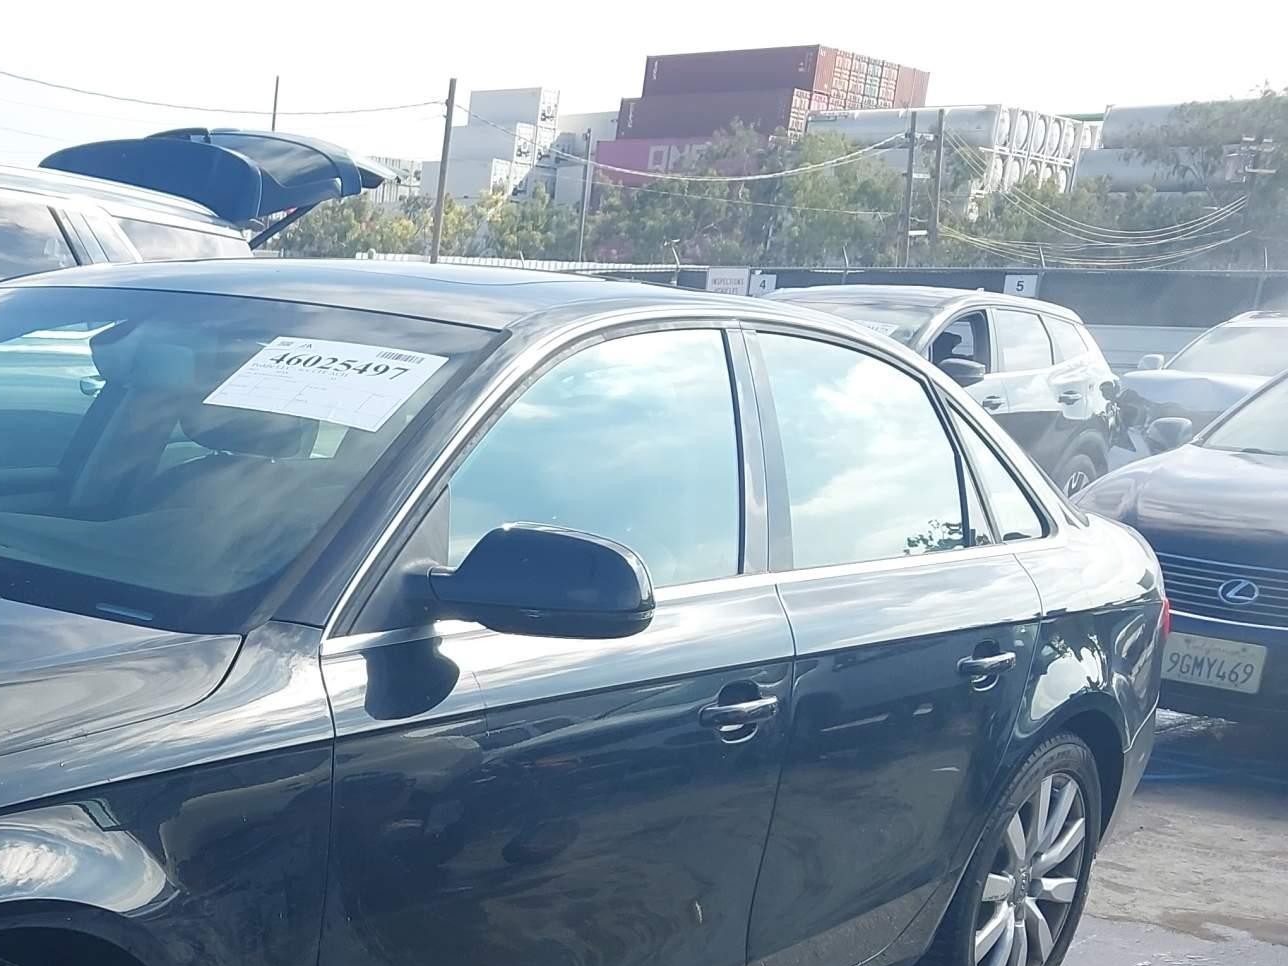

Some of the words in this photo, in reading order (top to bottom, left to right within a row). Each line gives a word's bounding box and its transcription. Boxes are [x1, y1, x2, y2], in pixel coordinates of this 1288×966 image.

[759, 279, 767, 290] 4
[1016, 280, 1025, 292] 5
[269, 352, 410, 381] 46025497
[1166, 652, 1255, 684] 9GMY469
